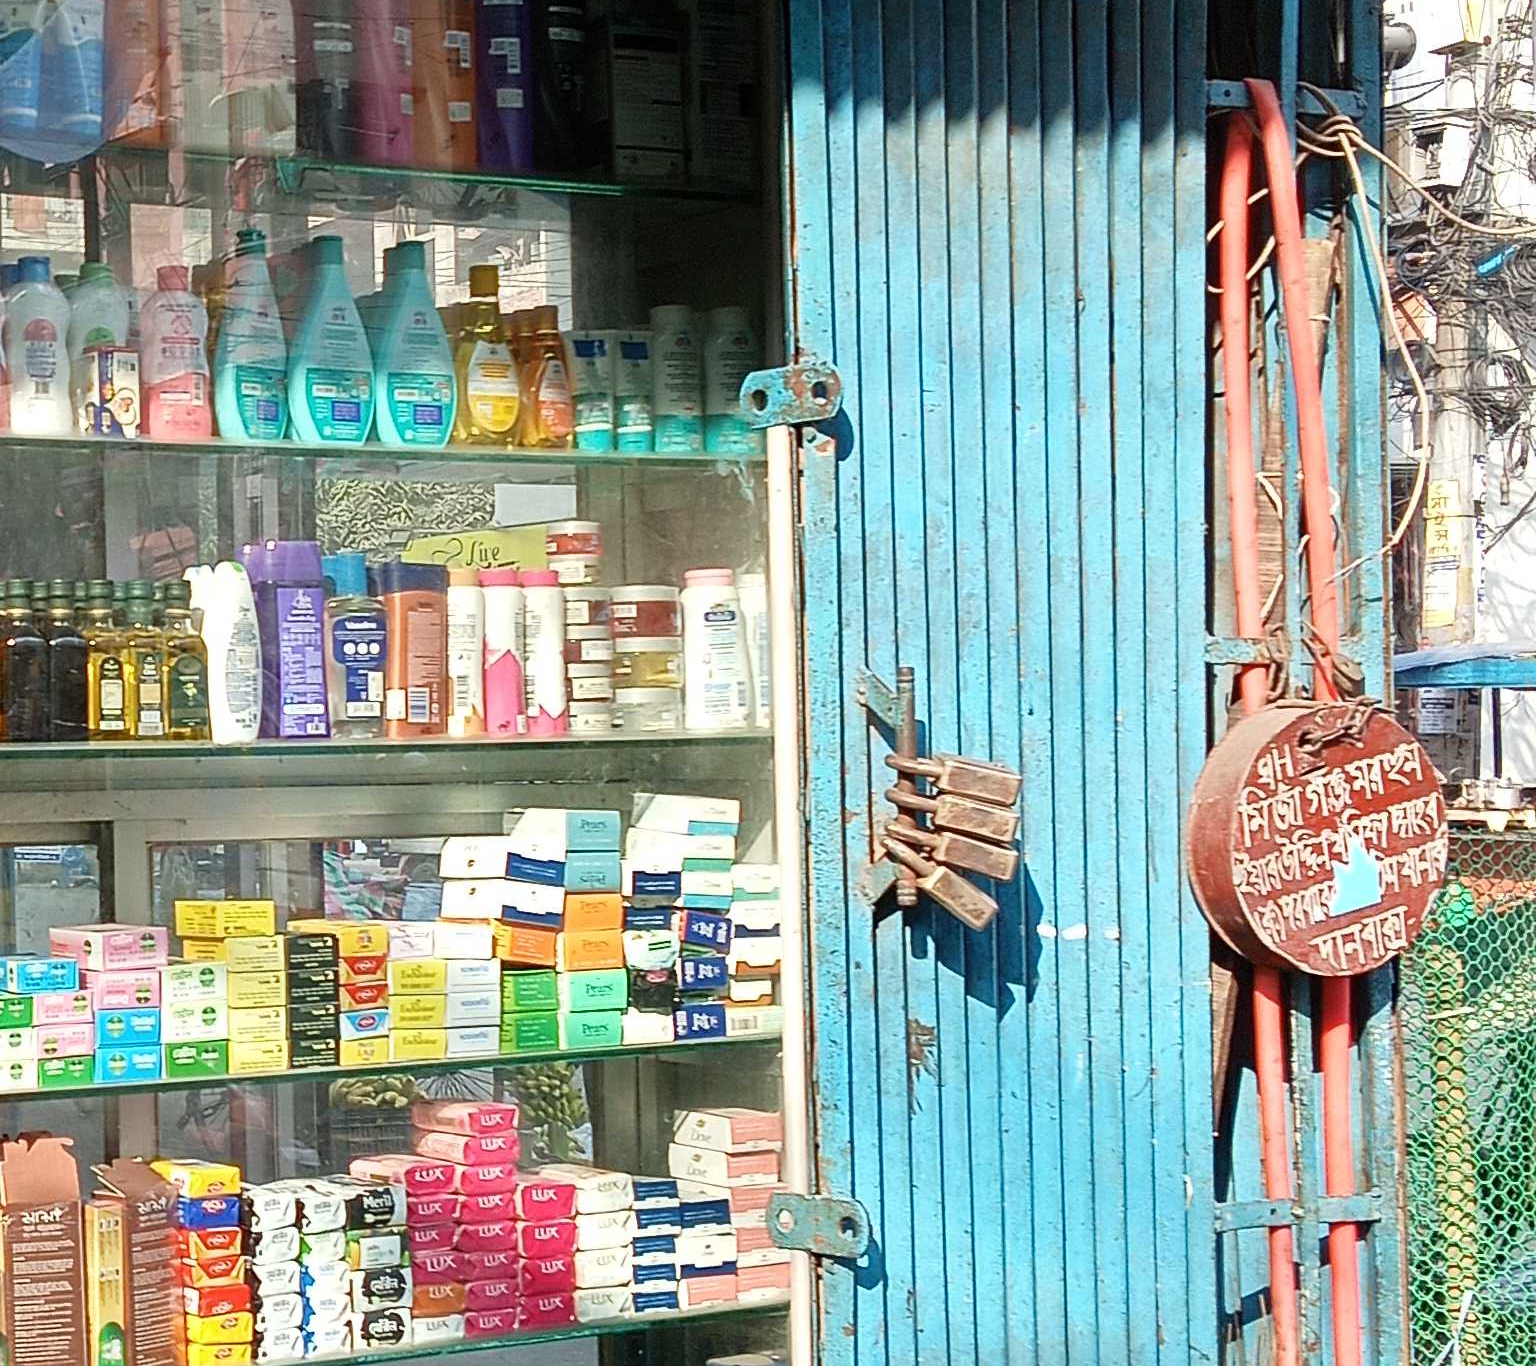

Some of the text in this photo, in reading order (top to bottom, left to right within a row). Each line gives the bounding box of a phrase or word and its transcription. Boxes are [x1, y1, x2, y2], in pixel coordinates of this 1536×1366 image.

[579, 818, 609, 830] Pears
[584, 983, 615, 996] Pears
[581, 1023, 610, 1036] Pears
[479, 1115, 504, 1127] LUX
[480, 1137, 508, 1151] LUX
[415, 1167, 447, 1182] LUX
[478, 1166, 506, 1180] LUX
[363, 1193, 393, 1209] Meril
[478, 1194, 504, 1208] LUX
[531, 1188, 559, 1202] LUX
[417, 1202, 444, 1215] LUX
[415, 1230, 442, 1243] LUX
[478, 1223, 505, 1237] LUX
[534, 1226, 561, 1240] LUX
[425, 1254, 457, 1273] LUX
[483, 1253, 509, 1267] LUX
[540, 1260, 567, 1274] LUX
[596, 1254, 619, 1267] LUX
[428, 1283, 457, 1298] LUX
[484, 1283, 510, 1297] LUX
[538, 1296, 565, 1310] LUX
[590, 1292, 615, 1305] LUX
[425, 1319, 451, 1331] LUX
[478, 1316, 504, 1330] LUX
